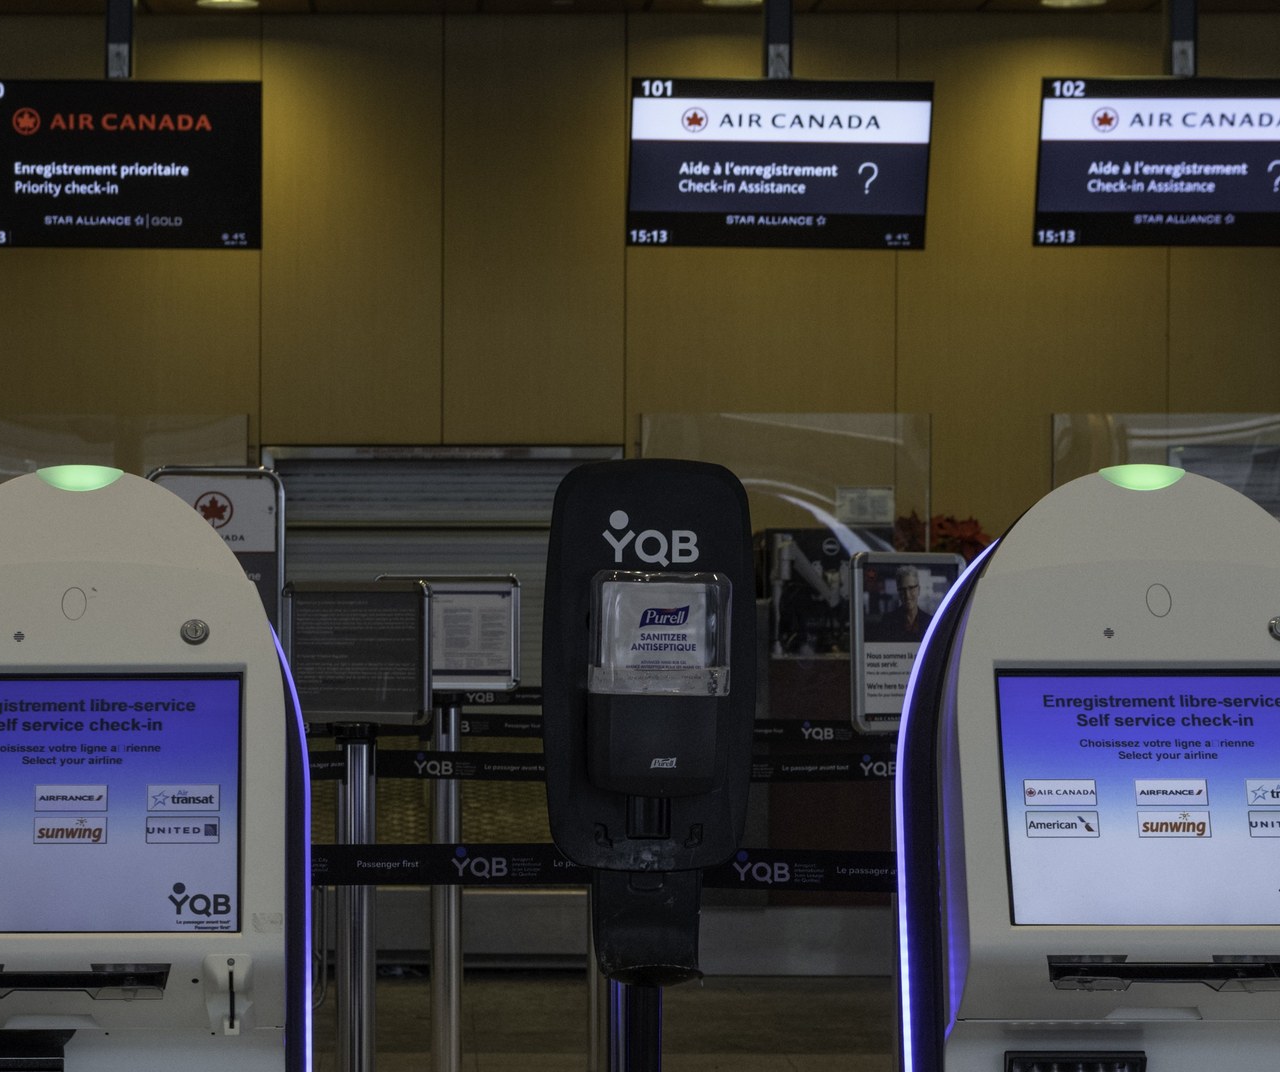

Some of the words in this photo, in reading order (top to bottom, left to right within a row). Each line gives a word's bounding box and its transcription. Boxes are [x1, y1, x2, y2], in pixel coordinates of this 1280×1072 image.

[641, 80, 673, 97] 101
[1052, 80, 1085, 97] 102
[50, 114, 94, 130] AIR
[101, 113, 212, 131] CANADA
[719, 113, 762, 129] AIR
[771, 113, 881, 130] CANADA
[1130, 112, 1173, 127] AIR
[14, 162, 117, 178] Enregistrement
[120, 163, 189, 179] prioritaire
[679, 162, 710, 175] Aide
[713, 162, 722, 175] à
[1088, 161, 1120, 175] Aide
[1122, 161, 1131, 175] à
[15, 181, 61, 197] Priority
[65, 181, 119, 194] check-in
[678, 180, 735, 193] Check-in
[738, 181, 806, 194] Assistance
[1087, 180, 1144, 193] Check-in
[1147, 180, 1215, 193] Assistance
[44, 215, 74, 226] STAR
[76, 215, 131, 226] ALLIANCE
[151, 215, 183, 227] GOLD
[725, 215, 755, 225] STAR
[757, 215, 814, 226] ALLIANCE
[630, 230, 668, 243] 15:13
[1037, 230, 1075, 243] 15:13
[602, 529, 699, 567] YQB
[646, 609, 685, 624] Purell
[640, 633, 687, 641] SANITIZER
[631, 643, 697, 652] ANTISEPTIQUE
[90, 699, 196, 712] libre-service
[1043, 694, 1174, 710] Enregistrement
[22, 719, 84, 732] service
[89, 718, 163, 731] check-in
[1076, 713, 1109, 727] Self
[1114, 715, 1176, 727] service
[1181, 713, 1254, 727] check-in
[801, 727, 834, 741] YQB
[1079, 739, 1140, 748] Choisissez
[1143, 740, 1171, 748] votre
[1174, 739, 1201, 750] ligne
[22, 756, 56, 765] Select
[60, 758, 84, 767] your
[88, 755, 123, 765] airline
[1118, 751, 1152, 760] Select
[1155, 753, 1180, 762] your
[1183, 751, 1218, 760] airline
[39, 794, 94, 802] AIRFRANCE
[171, 794, 214, 804] transat
[146, 826, 201, 834] UNITED
[1028, 820, 1077, 830] American
[1142, 820, 1206, 836] sunwing
[37, 825, 103, 842] sunwing
[357, 860, 400, 869] Passenger
[402, 860, 419, 868] first
[451, 857, 508, 878] YQB
[733, 862, 790, 884] YQB
[168, 894, 231, 917] YQB
